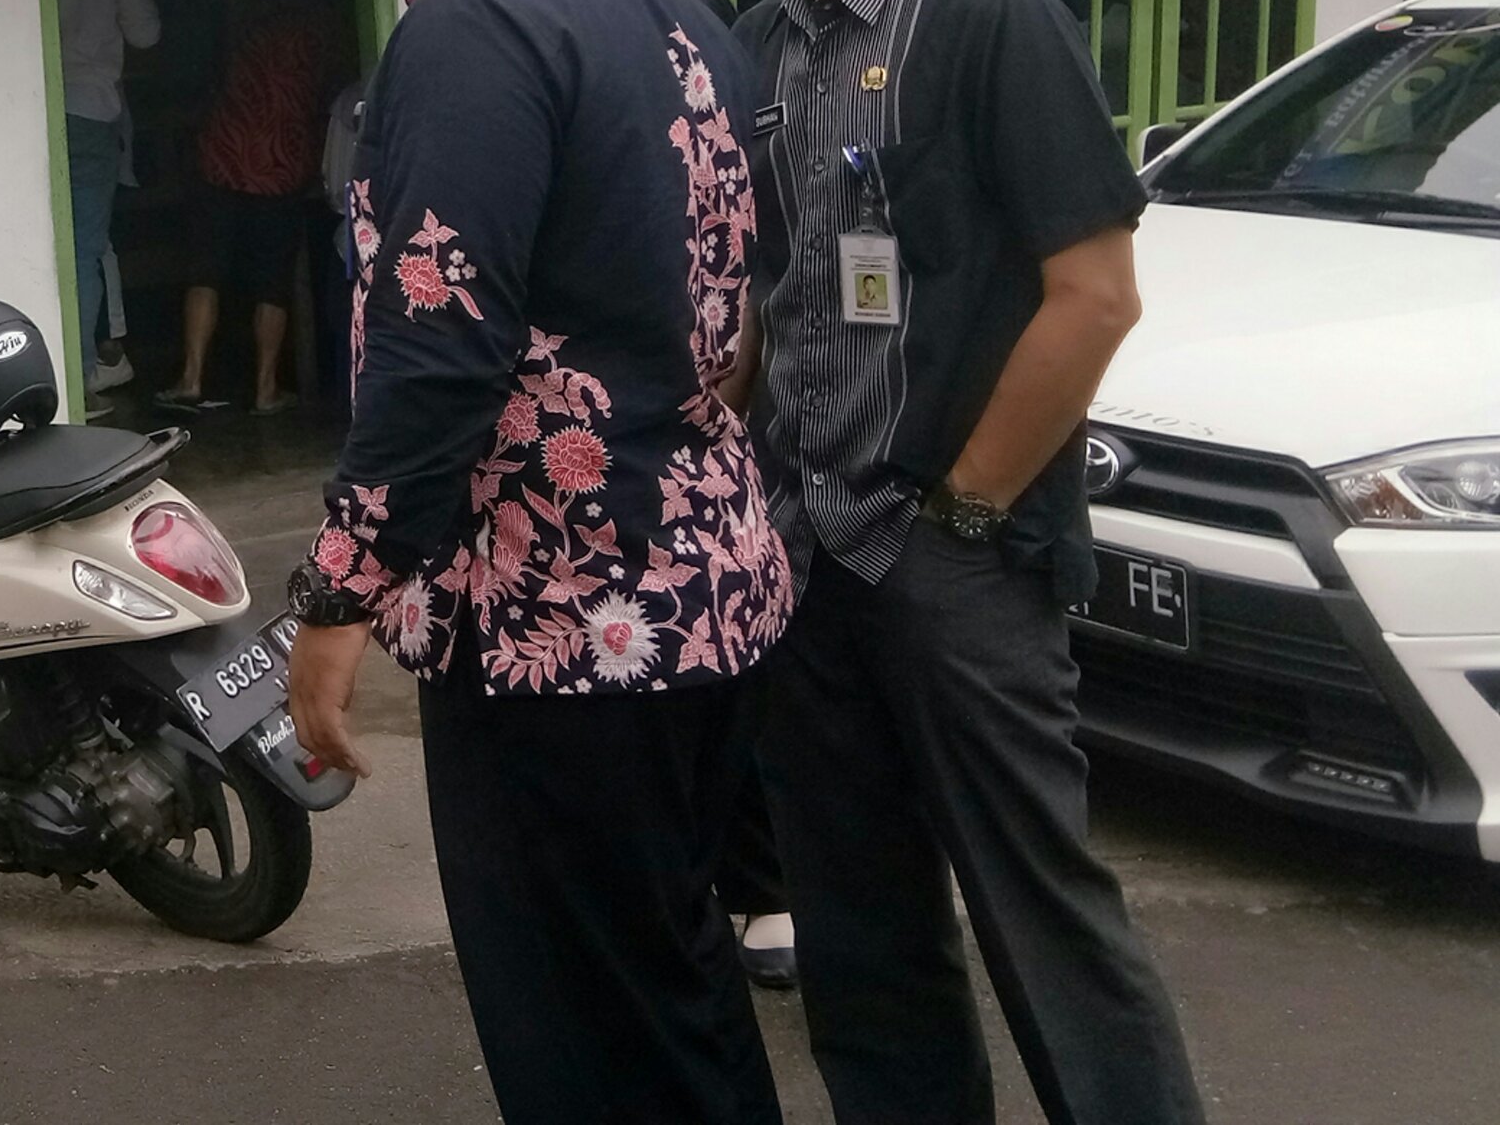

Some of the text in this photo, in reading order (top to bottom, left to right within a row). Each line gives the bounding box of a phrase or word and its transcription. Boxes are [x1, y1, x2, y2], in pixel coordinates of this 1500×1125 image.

[1128, 561, 1175, 617] FE
[185, 691, 212, 722] R
[215, 643, 274, 698] 6329
